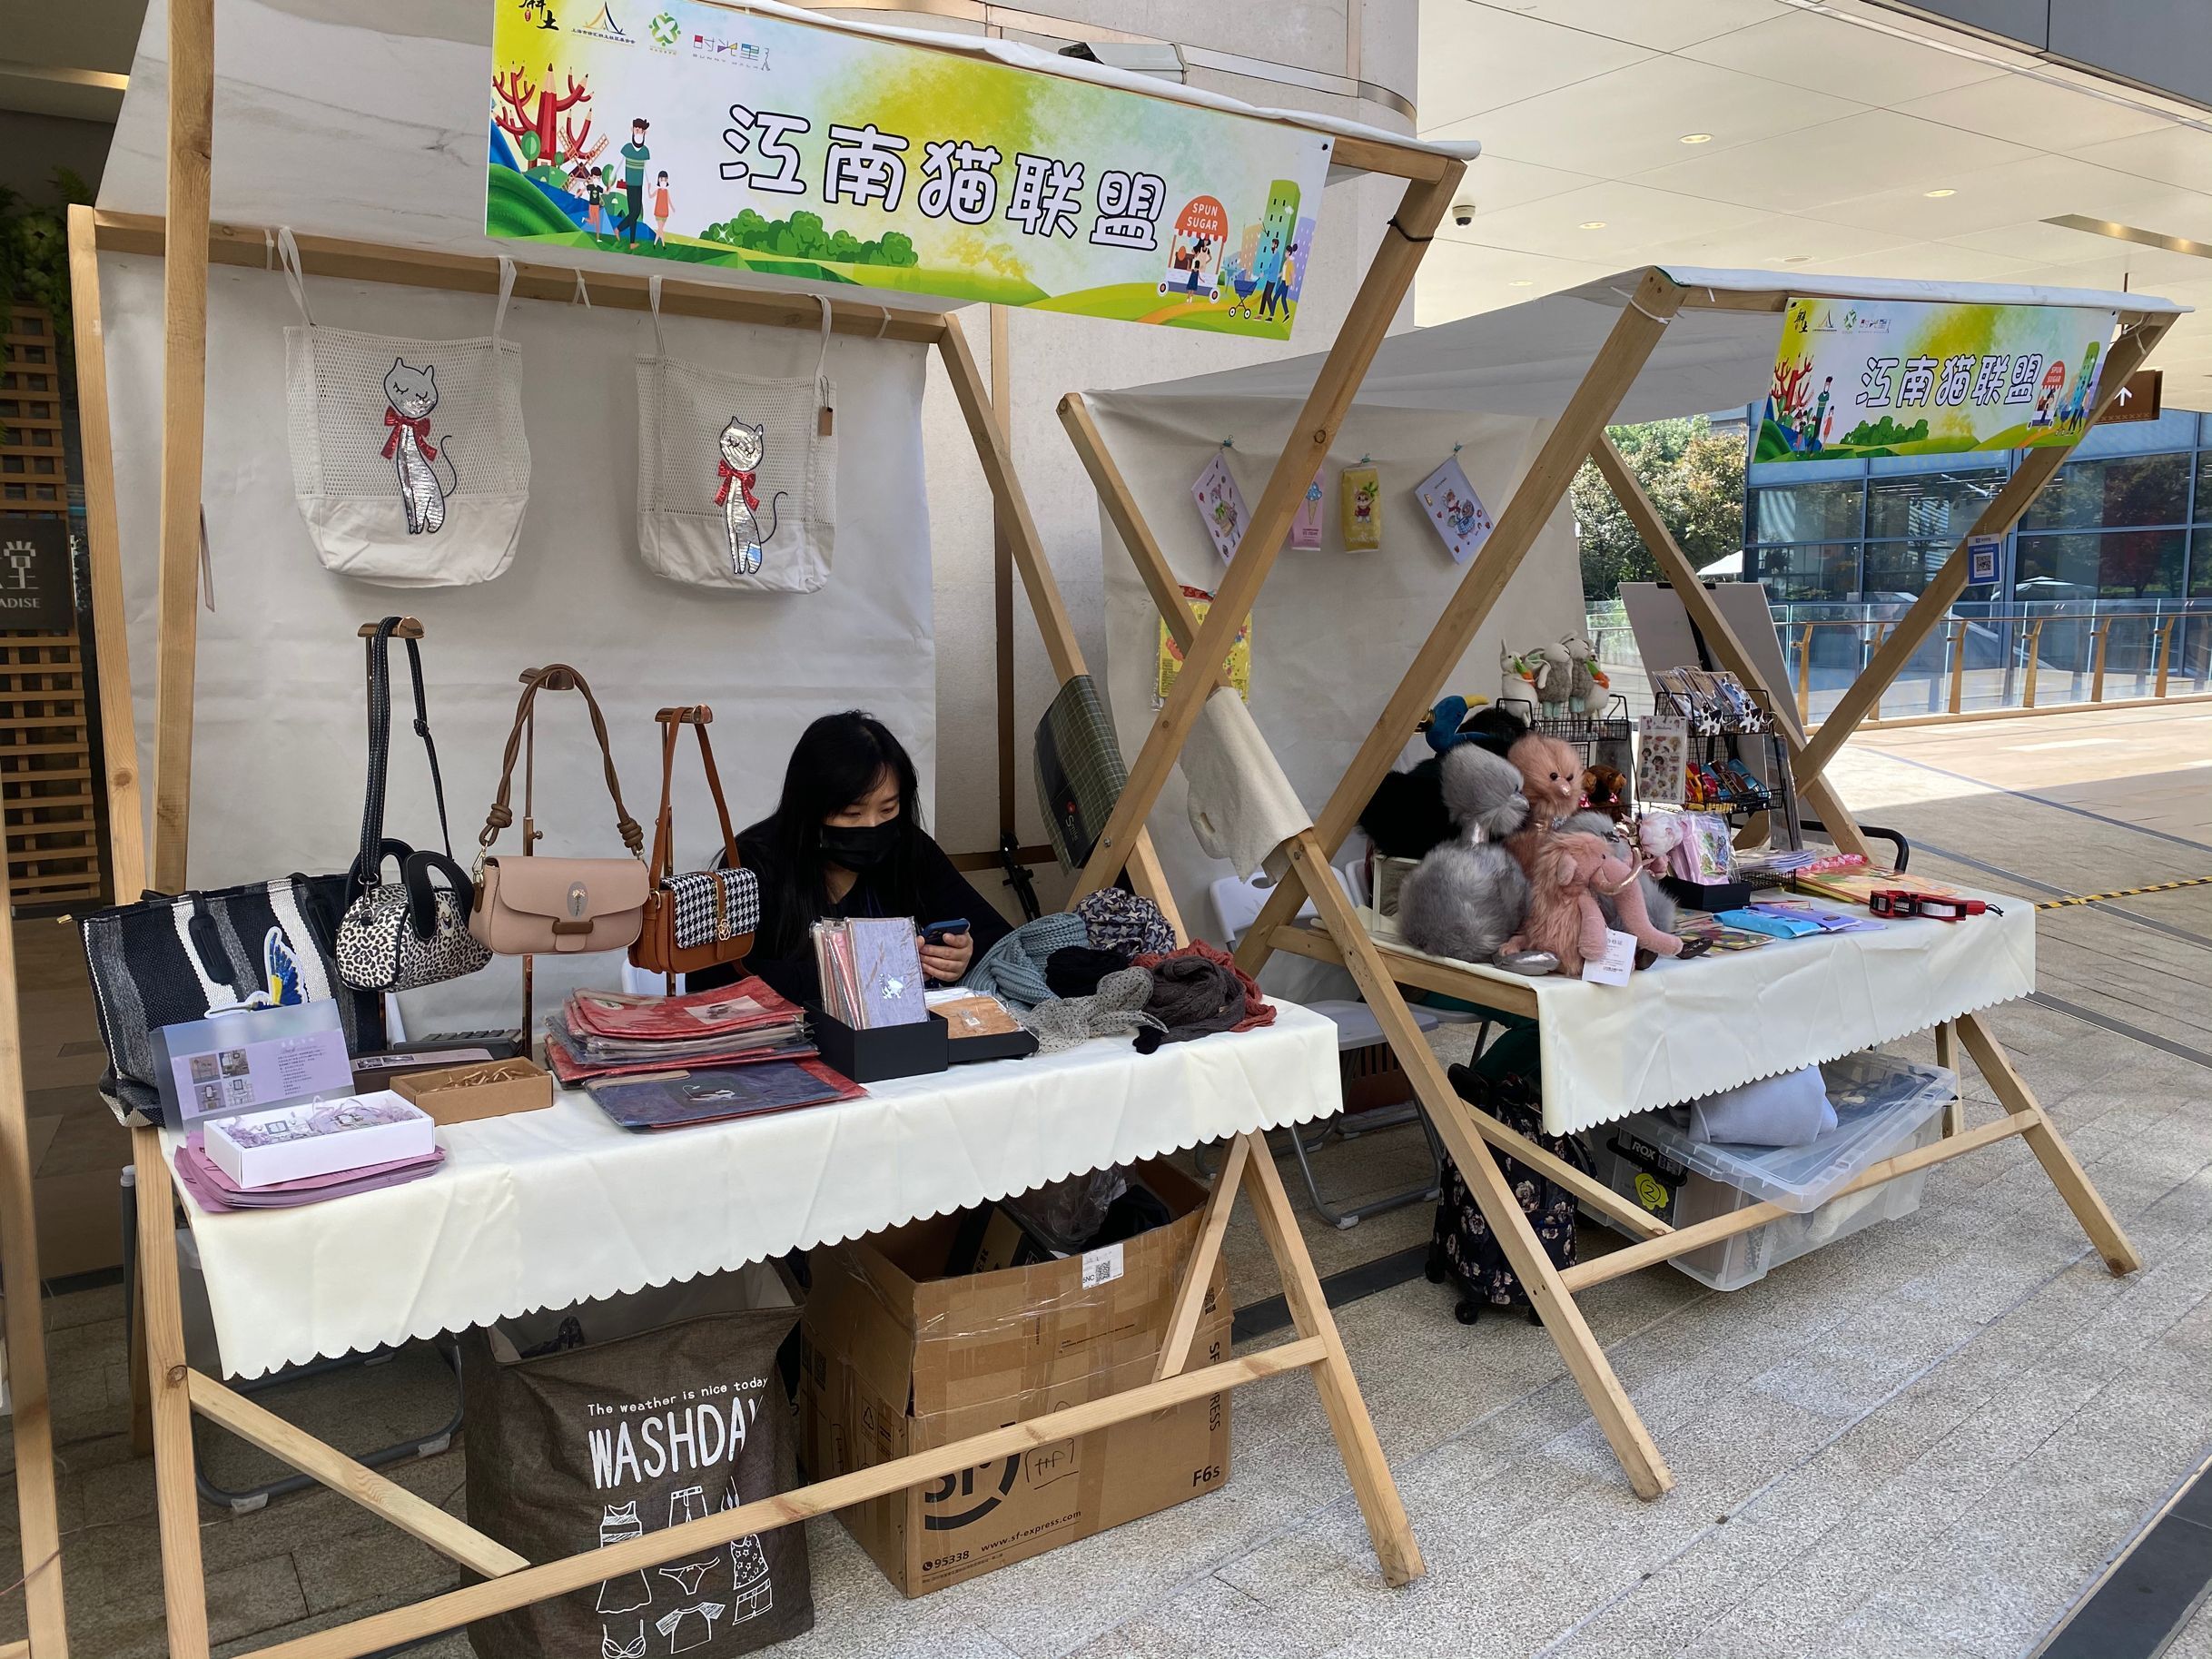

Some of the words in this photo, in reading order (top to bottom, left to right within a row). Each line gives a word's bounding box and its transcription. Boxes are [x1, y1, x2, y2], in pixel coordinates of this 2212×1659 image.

[719, 104, 1166, 252] 江南猫联盟
[1187, 216, 1218, 231] SUGAR
[1192, 202, 1218, 217] SPUN
[1855, 353, 2043, 409] 江南猫联盟
[0, 540, 39, 589] 堂
[588, 1404, 613, 1417] The
[619, 1396, 676, 1413] weather
[683, 1390, 696, 1400] is
[701, 1385, 727, 1397] nice
[734, 1377, 768, 1392] today
[1210, 1391, 1220, 1431] RESS
[1193, 1466, 1220, 1487] F6s
[981, 1510, 1081, 1552] www.sf-express.com
[934, 1550, 970, 1569] 95338
